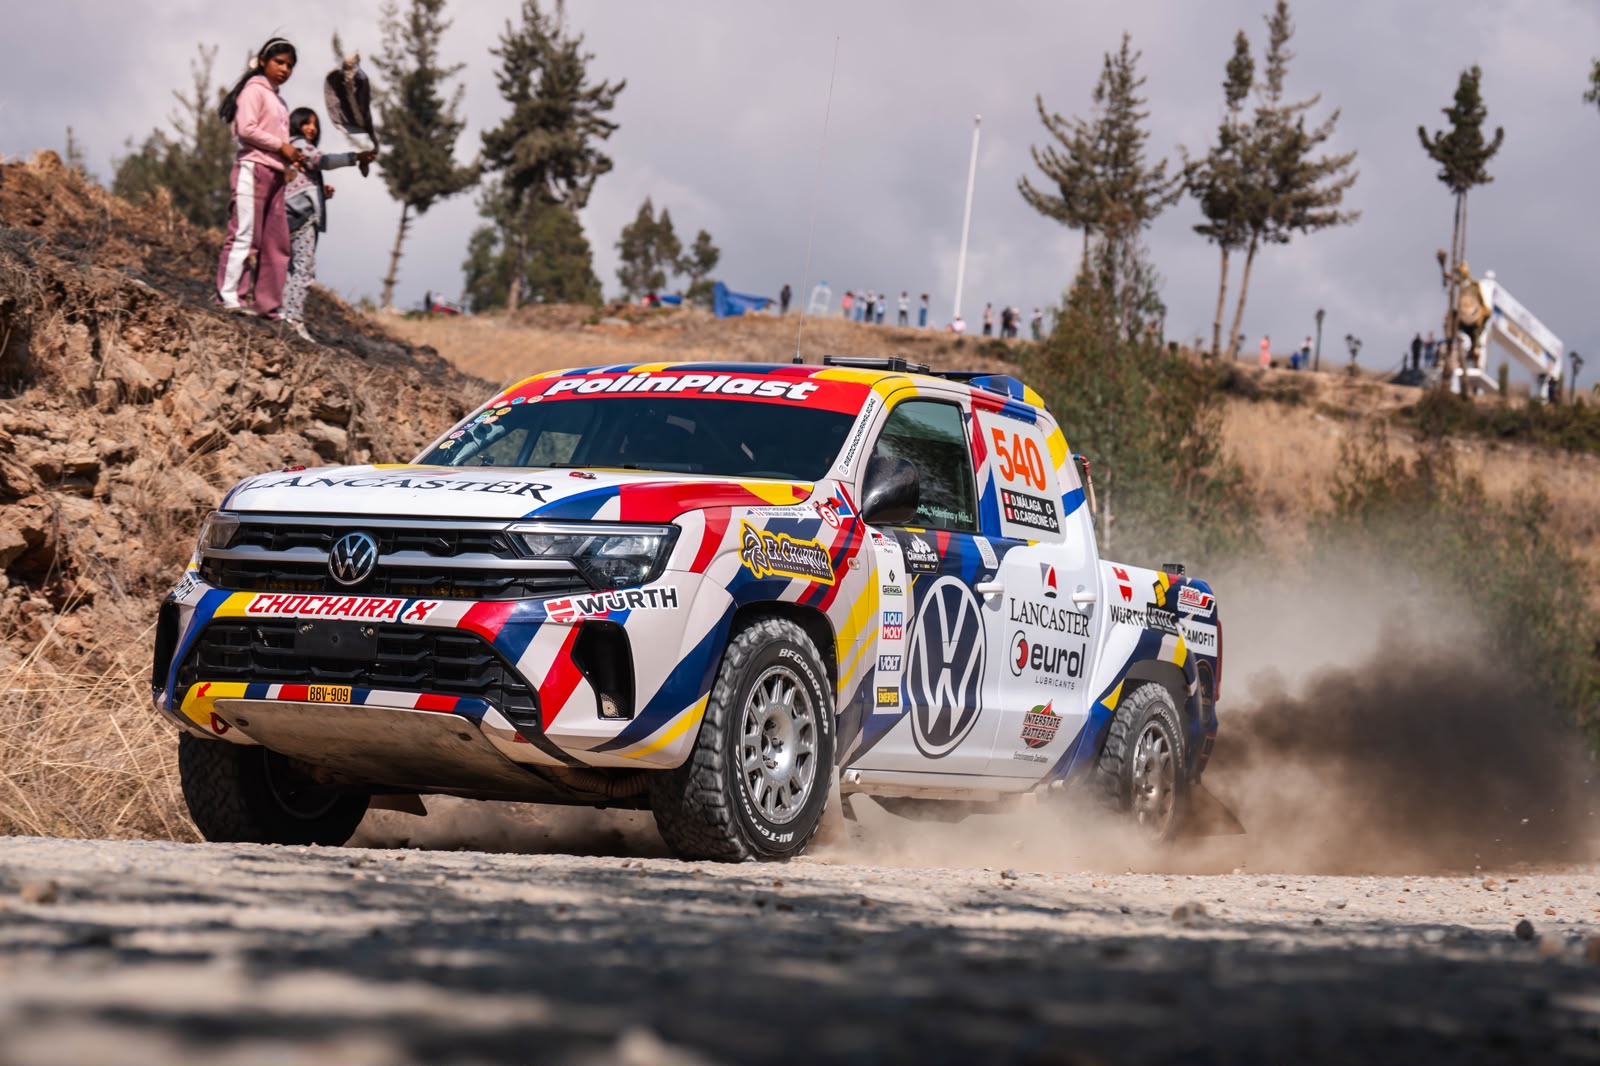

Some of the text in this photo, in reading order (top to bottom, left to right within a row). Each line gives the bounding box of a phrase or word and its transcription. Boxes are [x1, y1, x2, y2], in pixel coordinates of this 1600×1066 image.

[543, 372, 820, 400] PolinPlast
[991, 427, 1046, 491] 540
[236, 475, 553, 504] LANCASTER
[1013, 509, 1050, 527] O.CARBONE
[764, 538, 782, 560] EL
[248, 594, 438, 620] CHOCHAIRA X
[576, 588, 678, 614] WÜRTH
[884, 612, 902, 625] LIQUI
[1010, 597, 1090, 637] LANCASTER
[1110, 604, 1148, 627] WÜRTH
[883, 626, 902, 639] MOLY
[880, 656, 900, 670] VOLT
[1030, 643, 1086, 679] eurol
[310, 686, 349, 702] BBV-909
[779, 648, 829, 735] BFGoodrich
[1035, 676, 1075, 690] LUBRICANTS
[1025, 713, 1061, 728] INTERSTATE
[1022, 726, 1056, 740] BATTERIES
